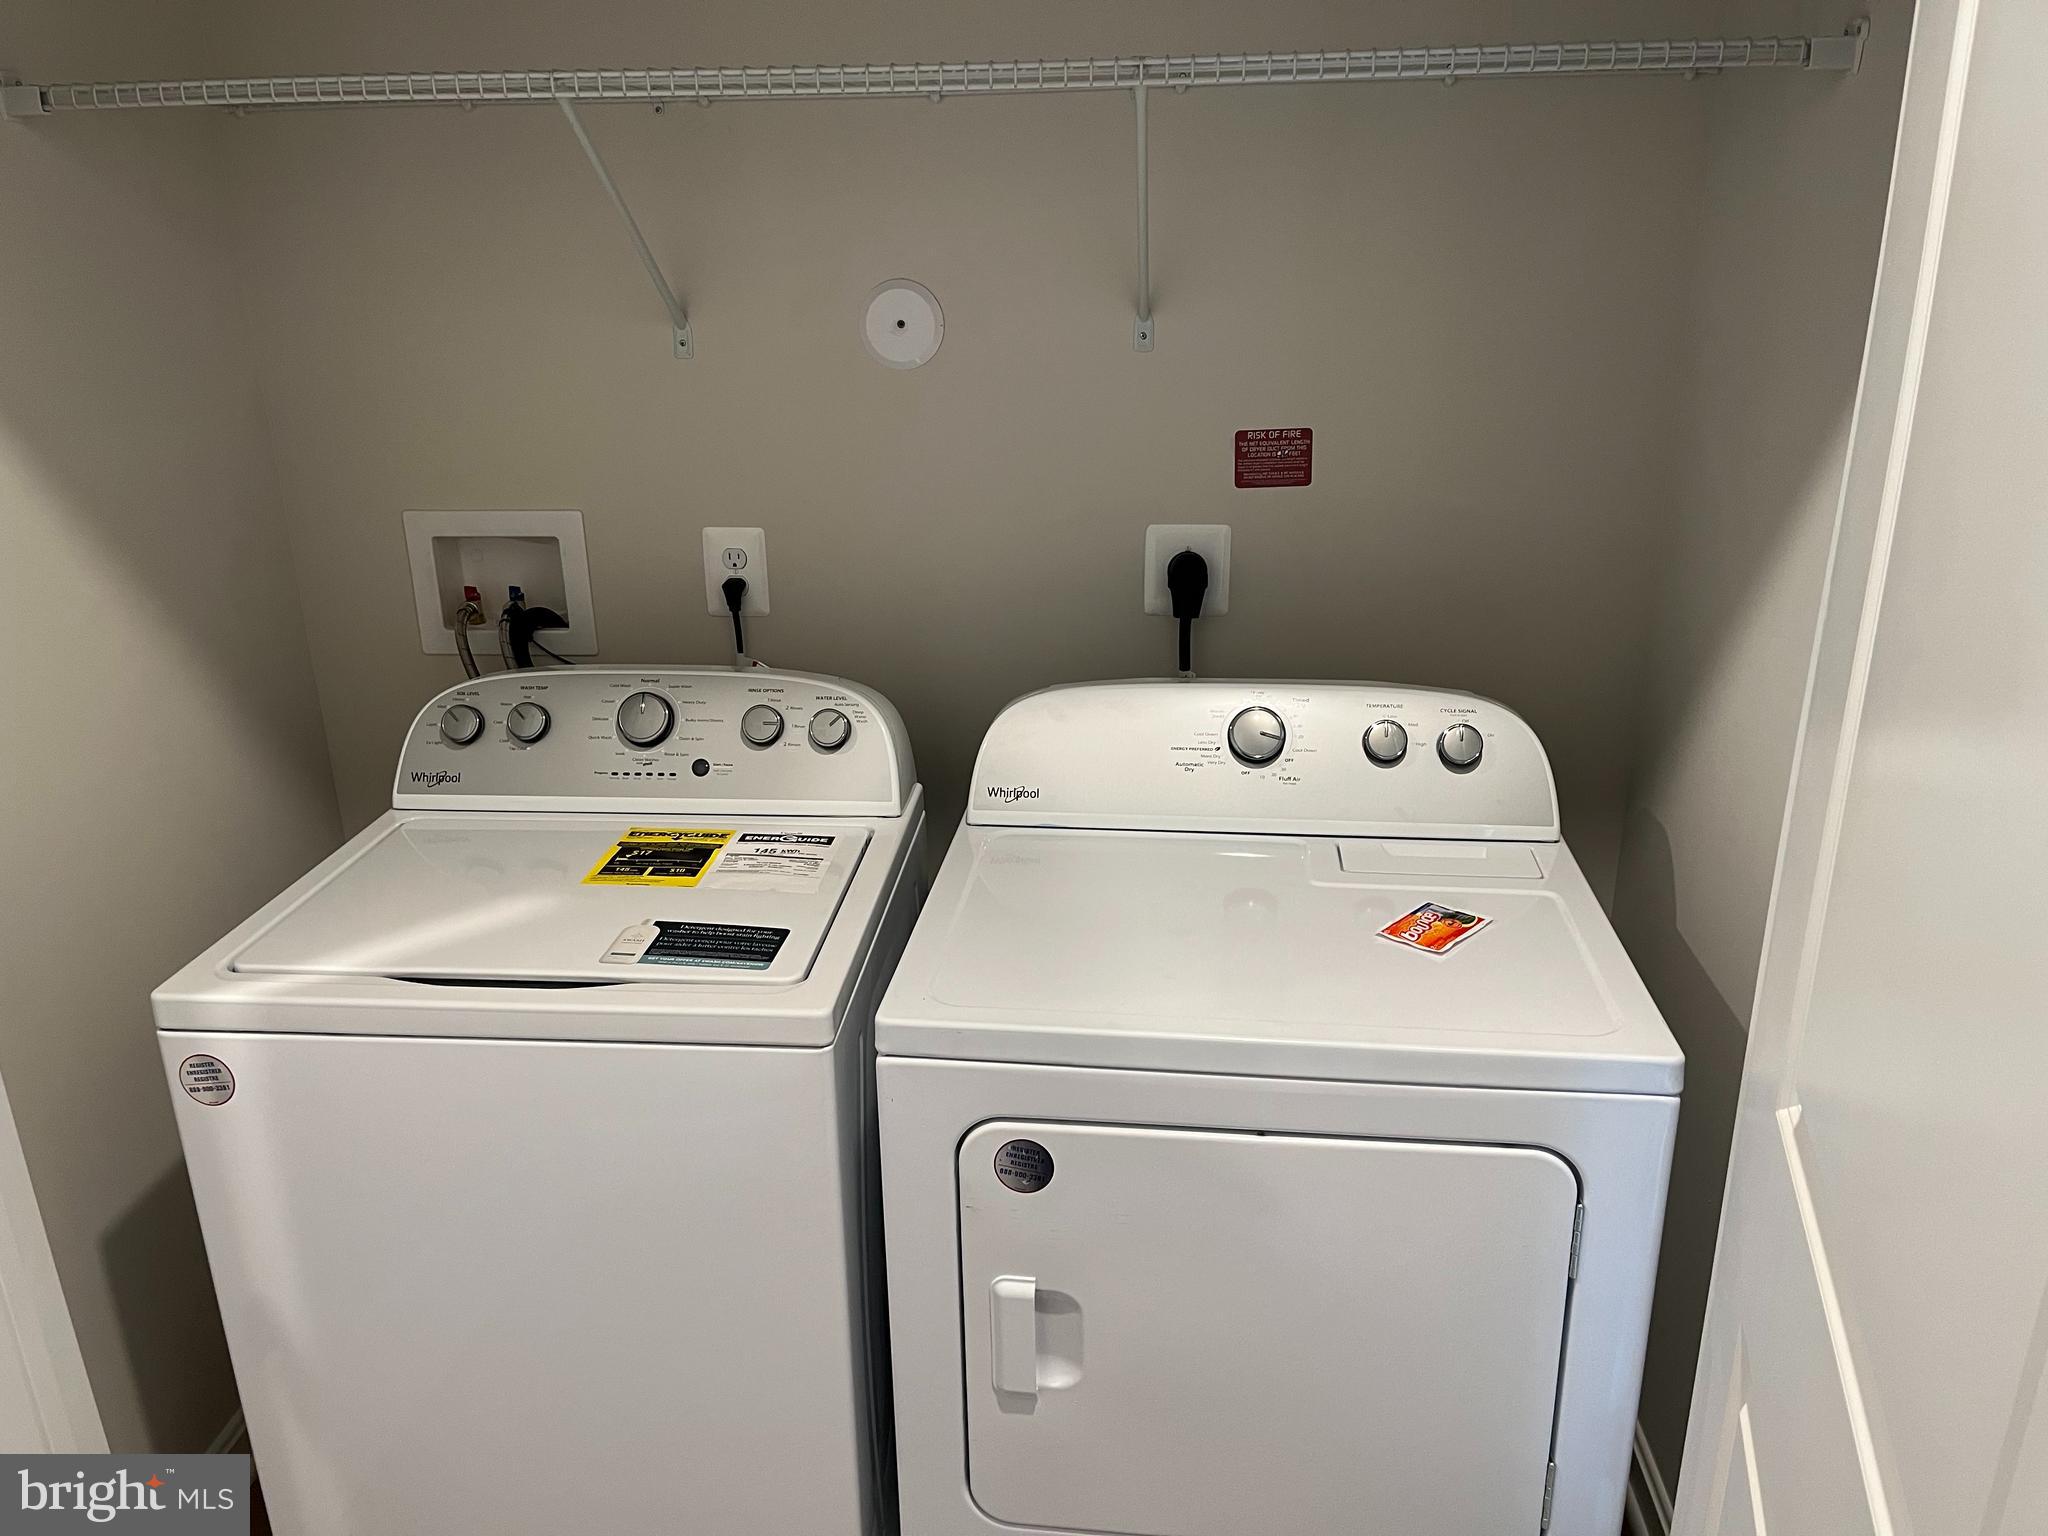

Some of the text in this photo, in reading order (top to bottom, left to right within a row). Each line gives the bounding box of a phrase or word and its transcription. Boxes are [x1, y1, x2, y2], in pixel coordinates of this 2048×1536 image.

[1247, 429, 1302, 439] RISK OF FIRE
[411, 770, 461, 788] Whirlpool
[987, 785, 1041, 804] Whirlpool
[680, 924, 714, 932] Detergent
[1400, 910, 1442, 942] bounce
